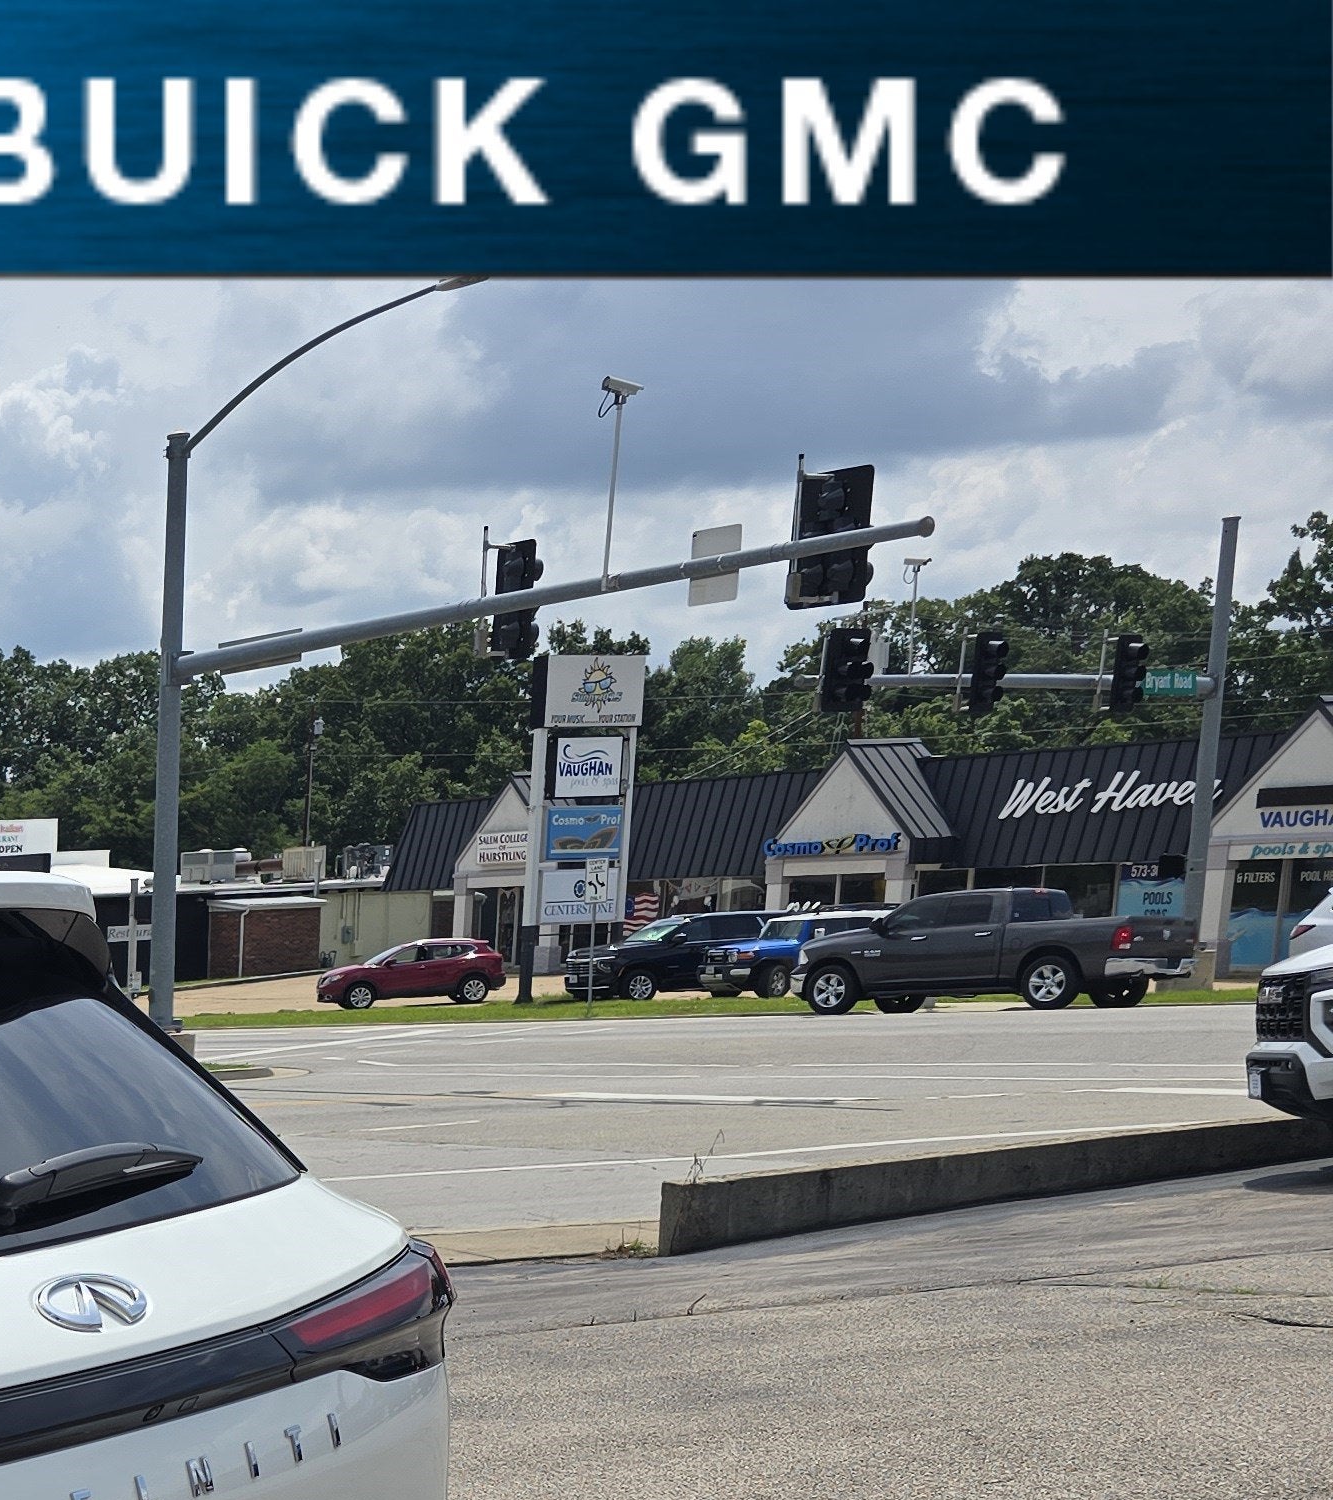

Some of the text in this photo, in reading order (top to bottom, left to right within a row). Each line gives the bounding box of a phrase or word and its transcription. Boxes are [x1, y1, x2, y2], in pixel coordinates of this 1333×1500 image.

[1145, 672, 1193, 692] Bryant Road
[559, 761, 613, 776] VAUGHAN
[998, 777, 1092, 820] West
[553, 814, 585, 825] Cosmo
[479, 834, 528, 845] SALEM COLLEGE
[763, 832, 902, 857] Cosmo Prof
[479, 851, 526, 862] HAIRSTYLING
[1250, 842, 1296, 860] pools
[1298, 841, 1310, 855] &
[1243, 872, 1276, 883] FILTERS
[1300, 871, 1321, 882] POOL
[1143, 892, 1173, 905] POOLS
